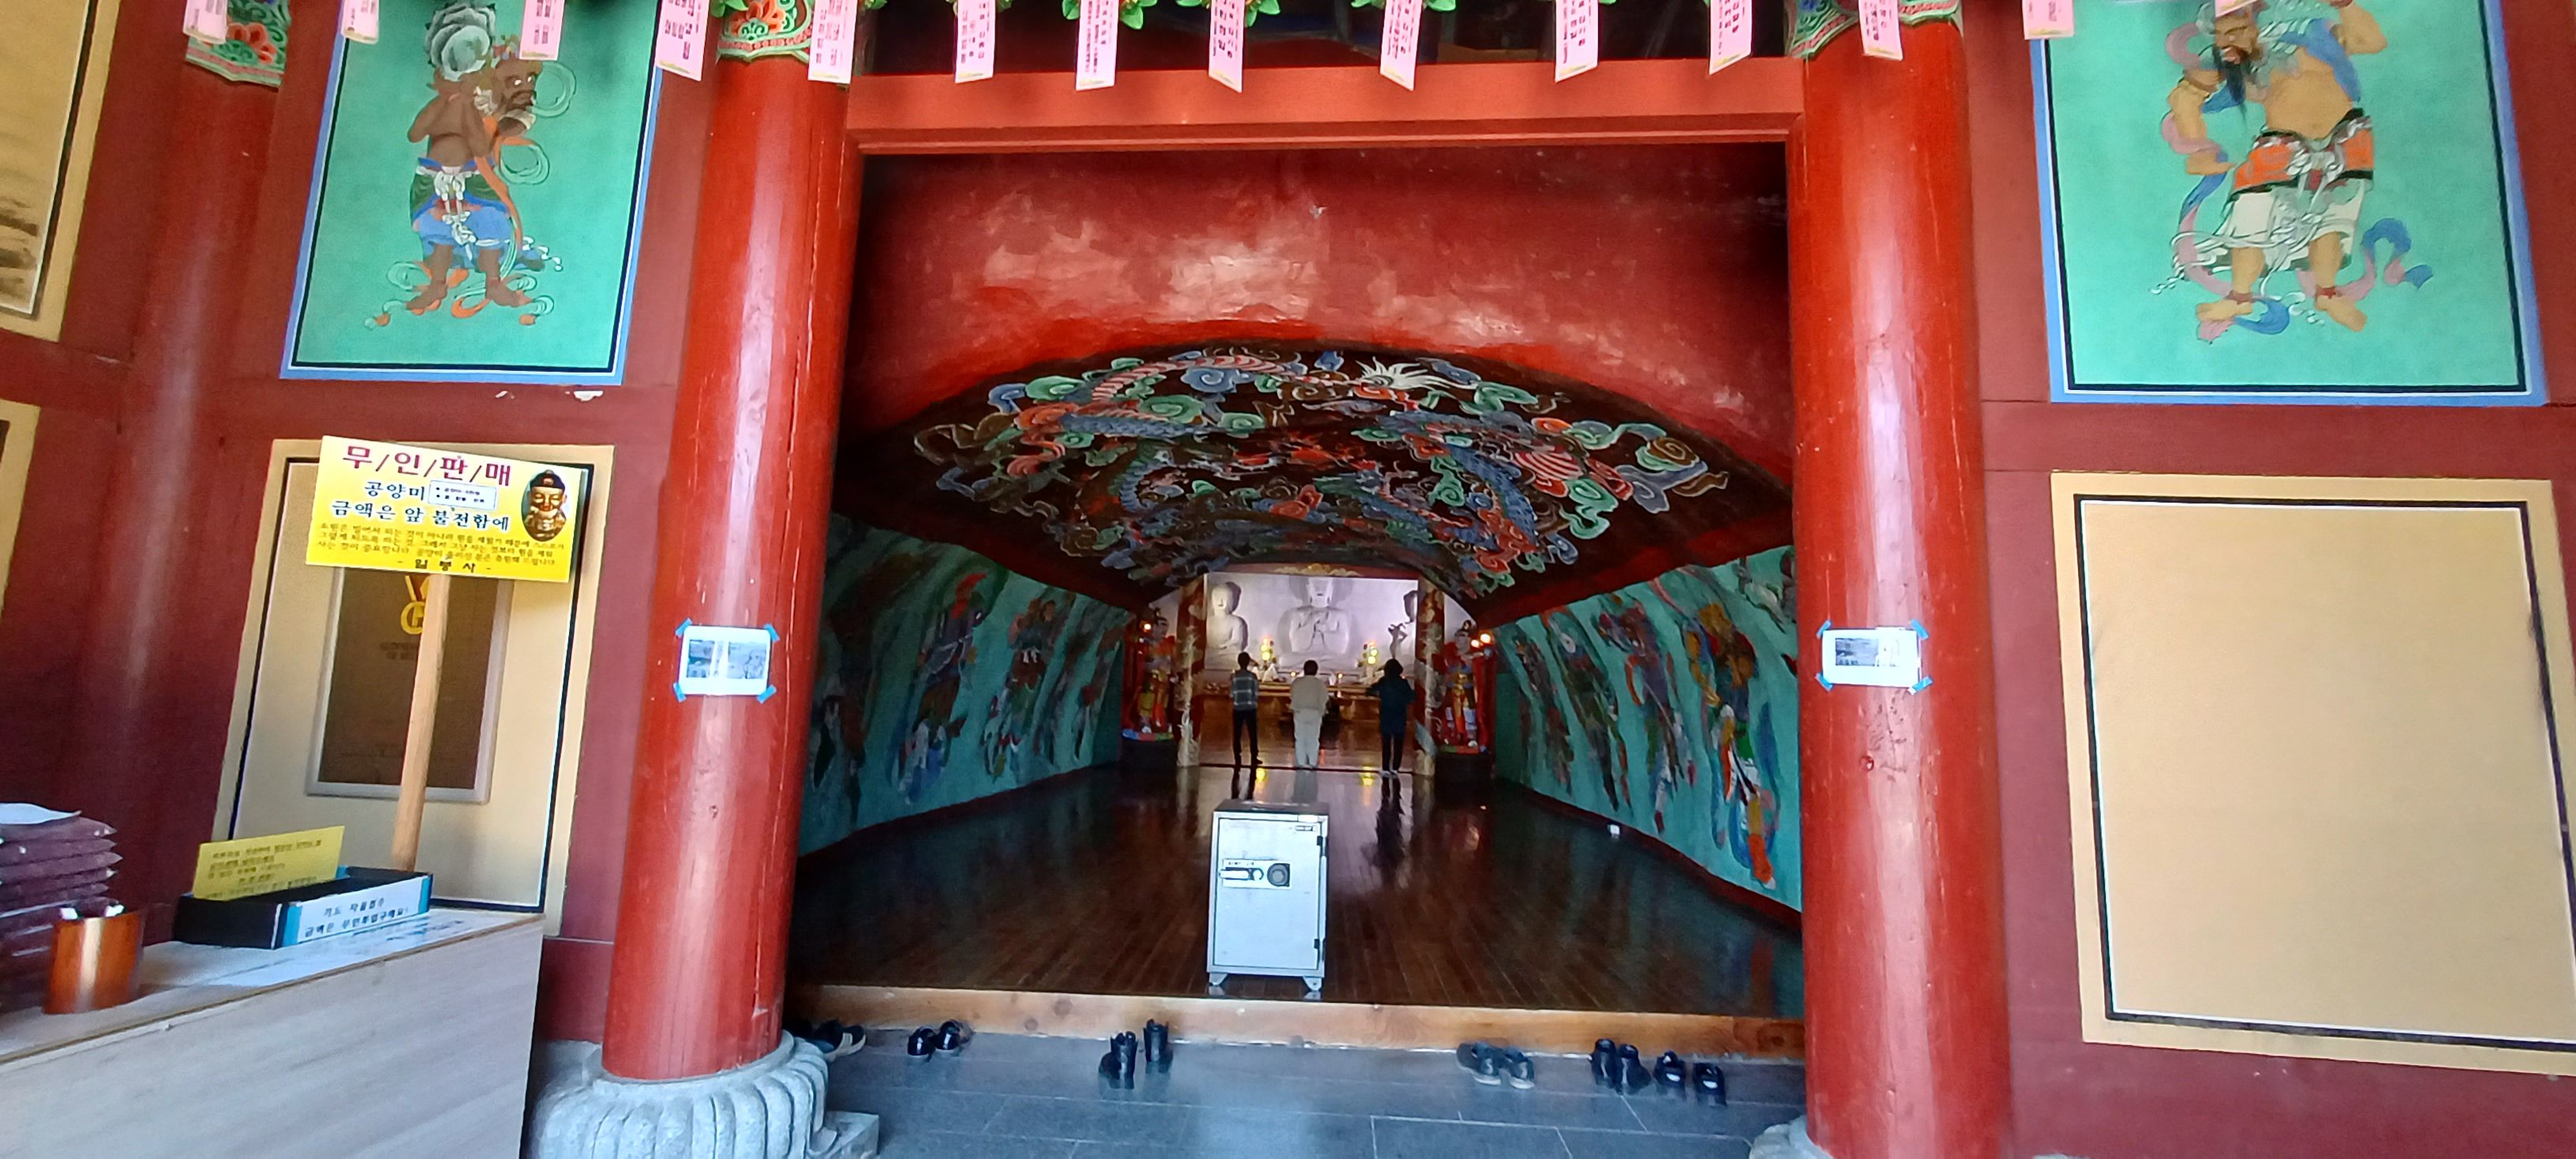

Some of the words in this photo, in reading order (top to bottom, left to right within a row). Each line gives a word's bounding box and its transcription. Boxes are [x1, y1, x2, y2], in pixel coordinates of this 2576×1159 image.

[364, 480, 425, 501] 공양미
[331, 500, 396, 519] 금액은
[405, 507, 424, 523] 앞
[432, 509, 509, 531] 불전함에
